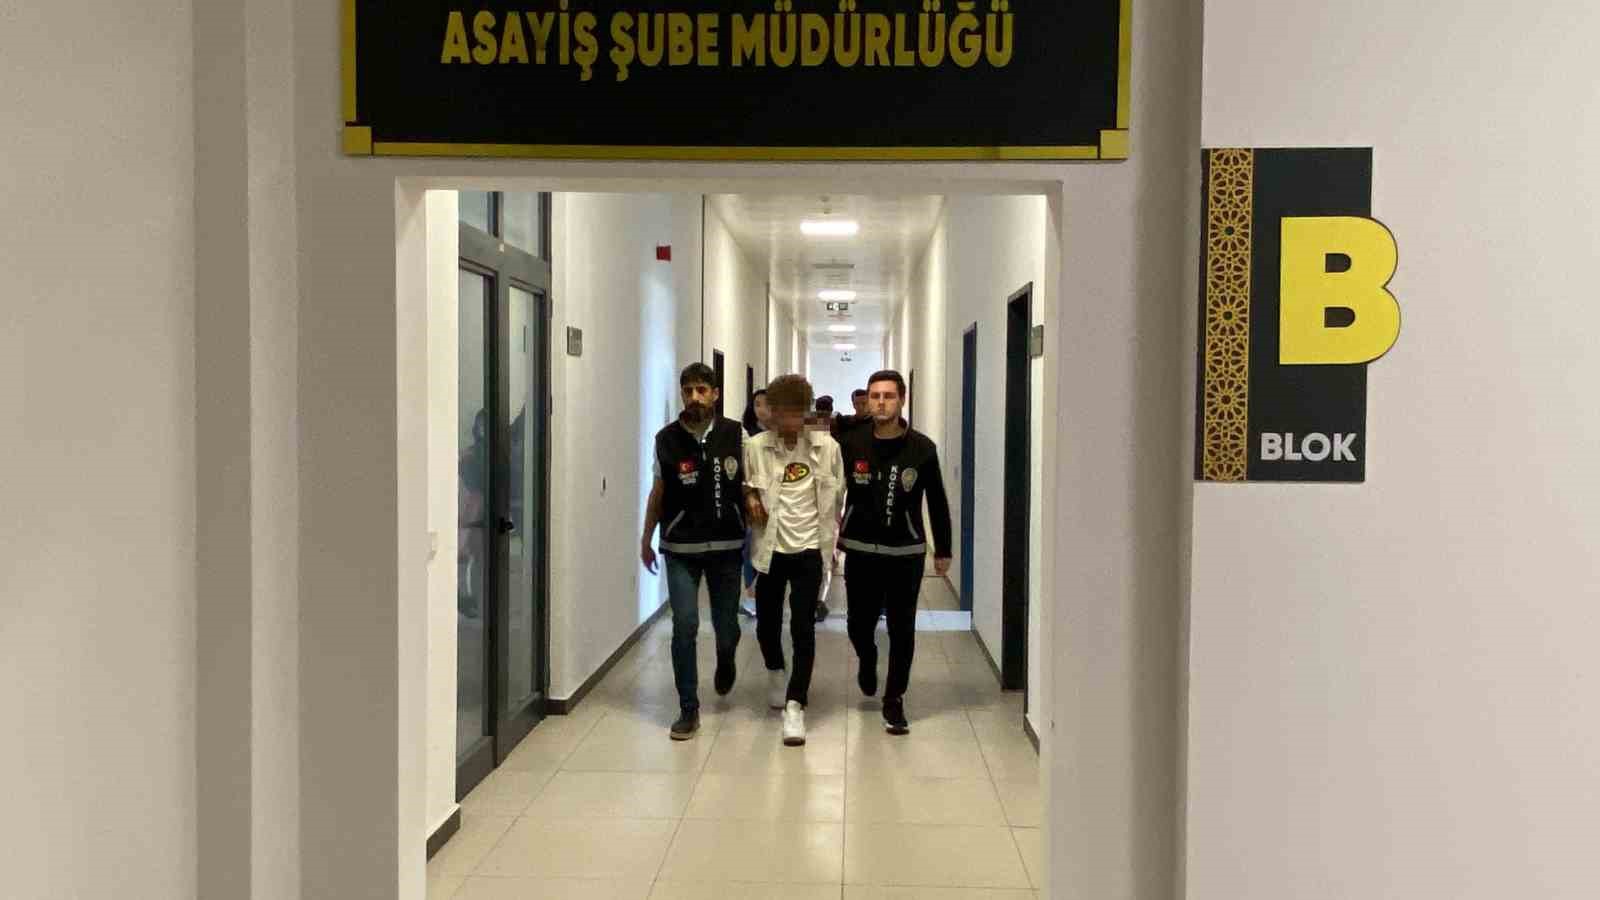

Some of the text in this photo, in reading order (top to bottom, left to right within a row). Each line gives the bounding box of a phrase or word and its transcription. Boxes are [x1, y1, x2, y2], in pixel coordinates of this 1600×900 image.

[440, 0, 1014, 81] ASAYİŞ ŞUBE MÜDÜRLÜĞÜ
[1279, 215, 1402, 365] B
[1260, 432, 1357, 462] BLOK
